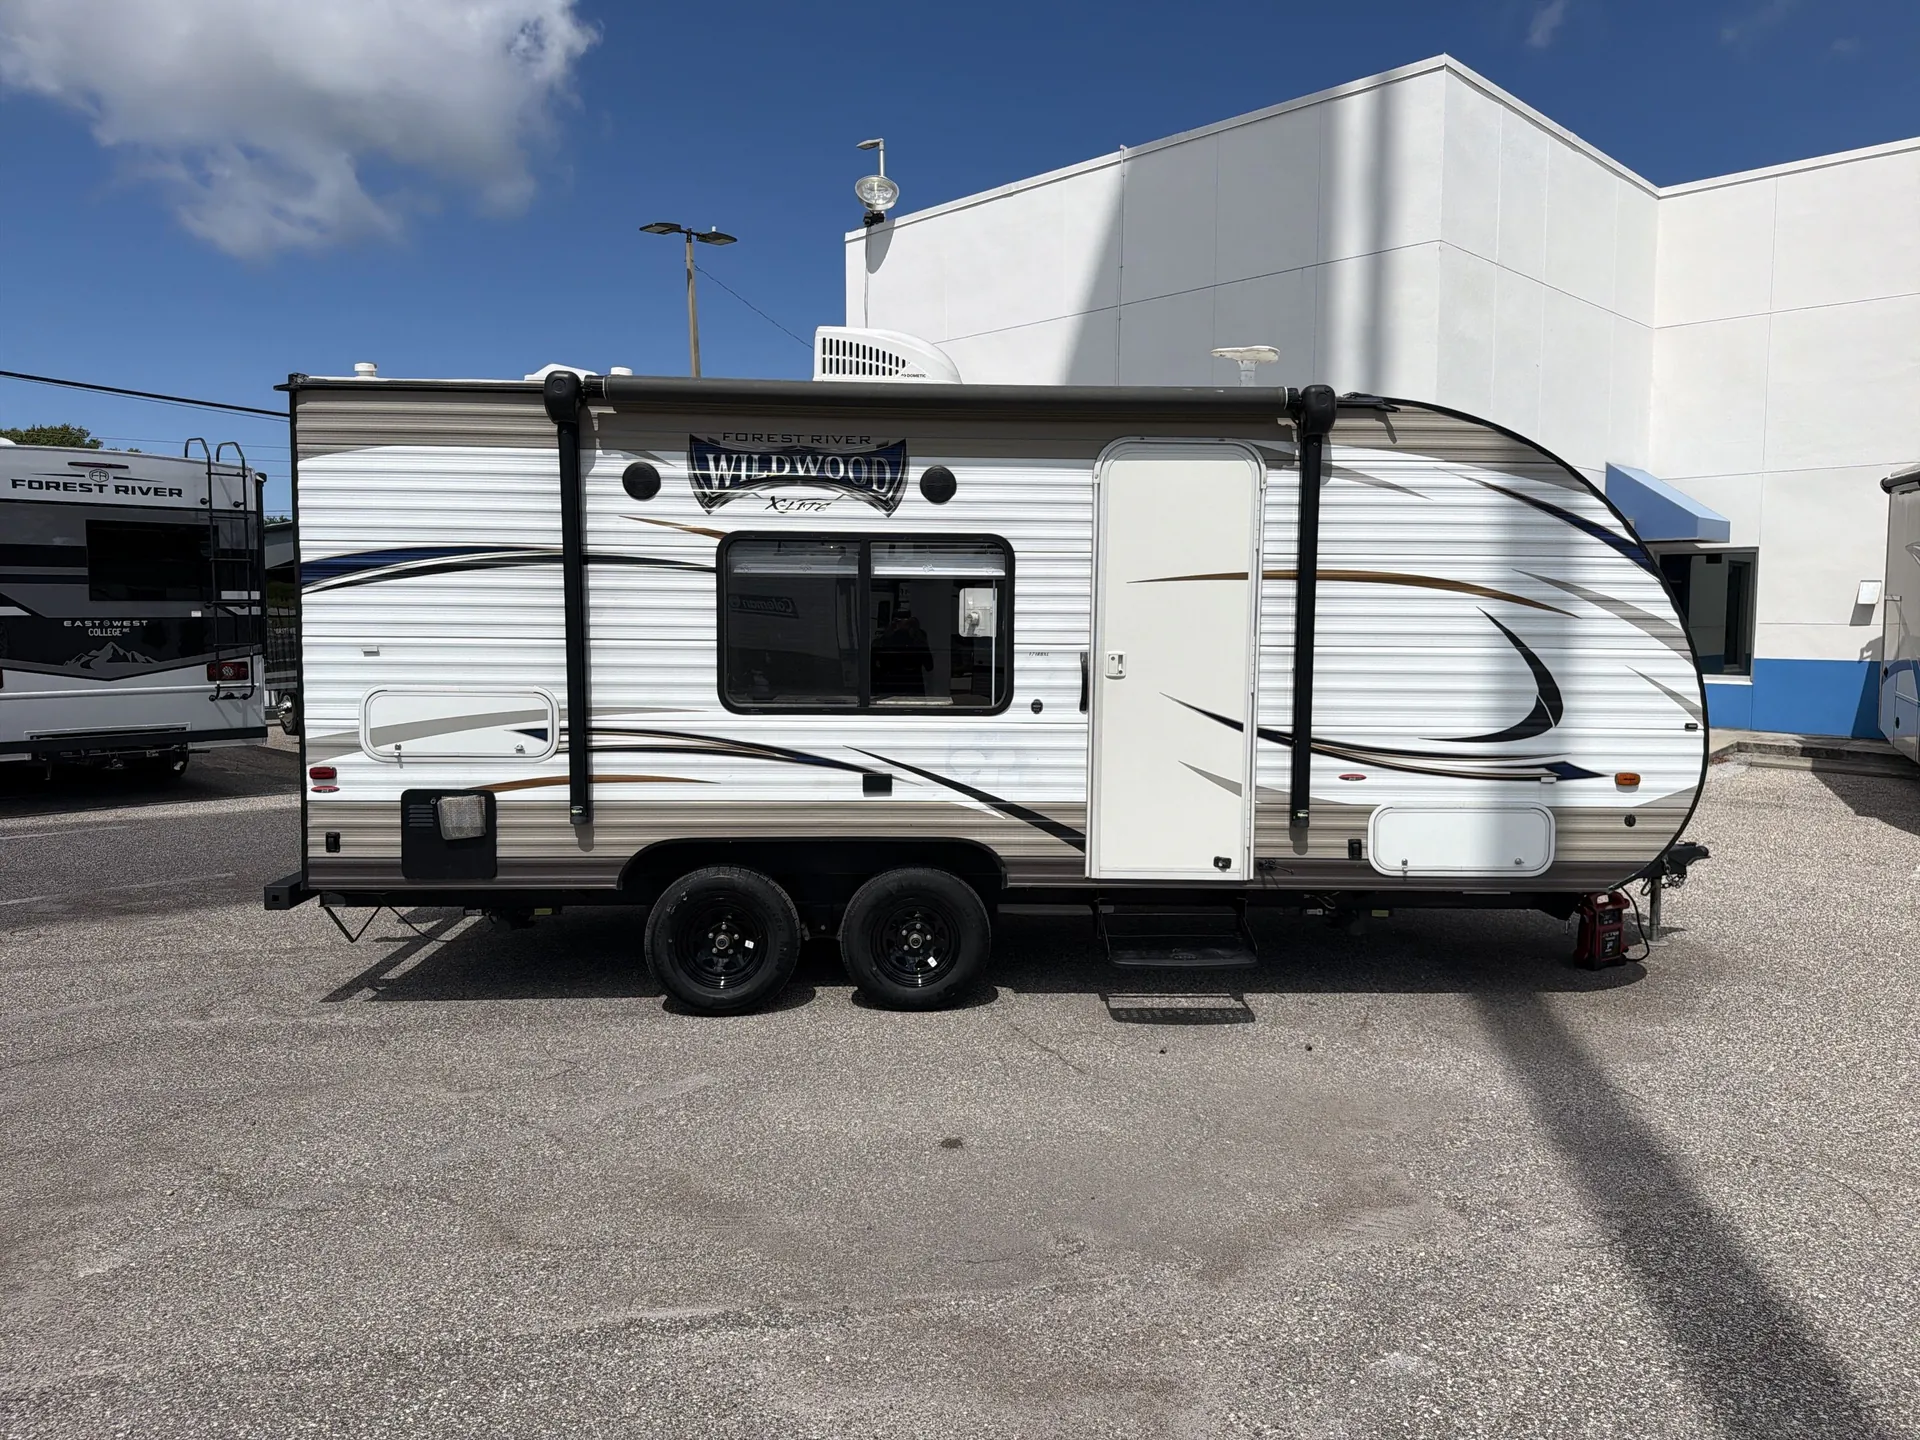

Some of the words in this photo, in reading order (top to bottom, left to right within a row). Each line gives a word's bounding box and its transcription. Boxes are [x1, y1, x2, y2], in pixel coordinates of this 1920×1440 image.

[723, 432, 805, 444] FOREST
[811, 434, 871, 445] RIVER
[706, 453, 891, 493] WILDWOOD
[11, 478, 108, 494] FOREST
[114, 485, 183, 498] RIVER
[88, 628, 122, 637] COLLEGE
